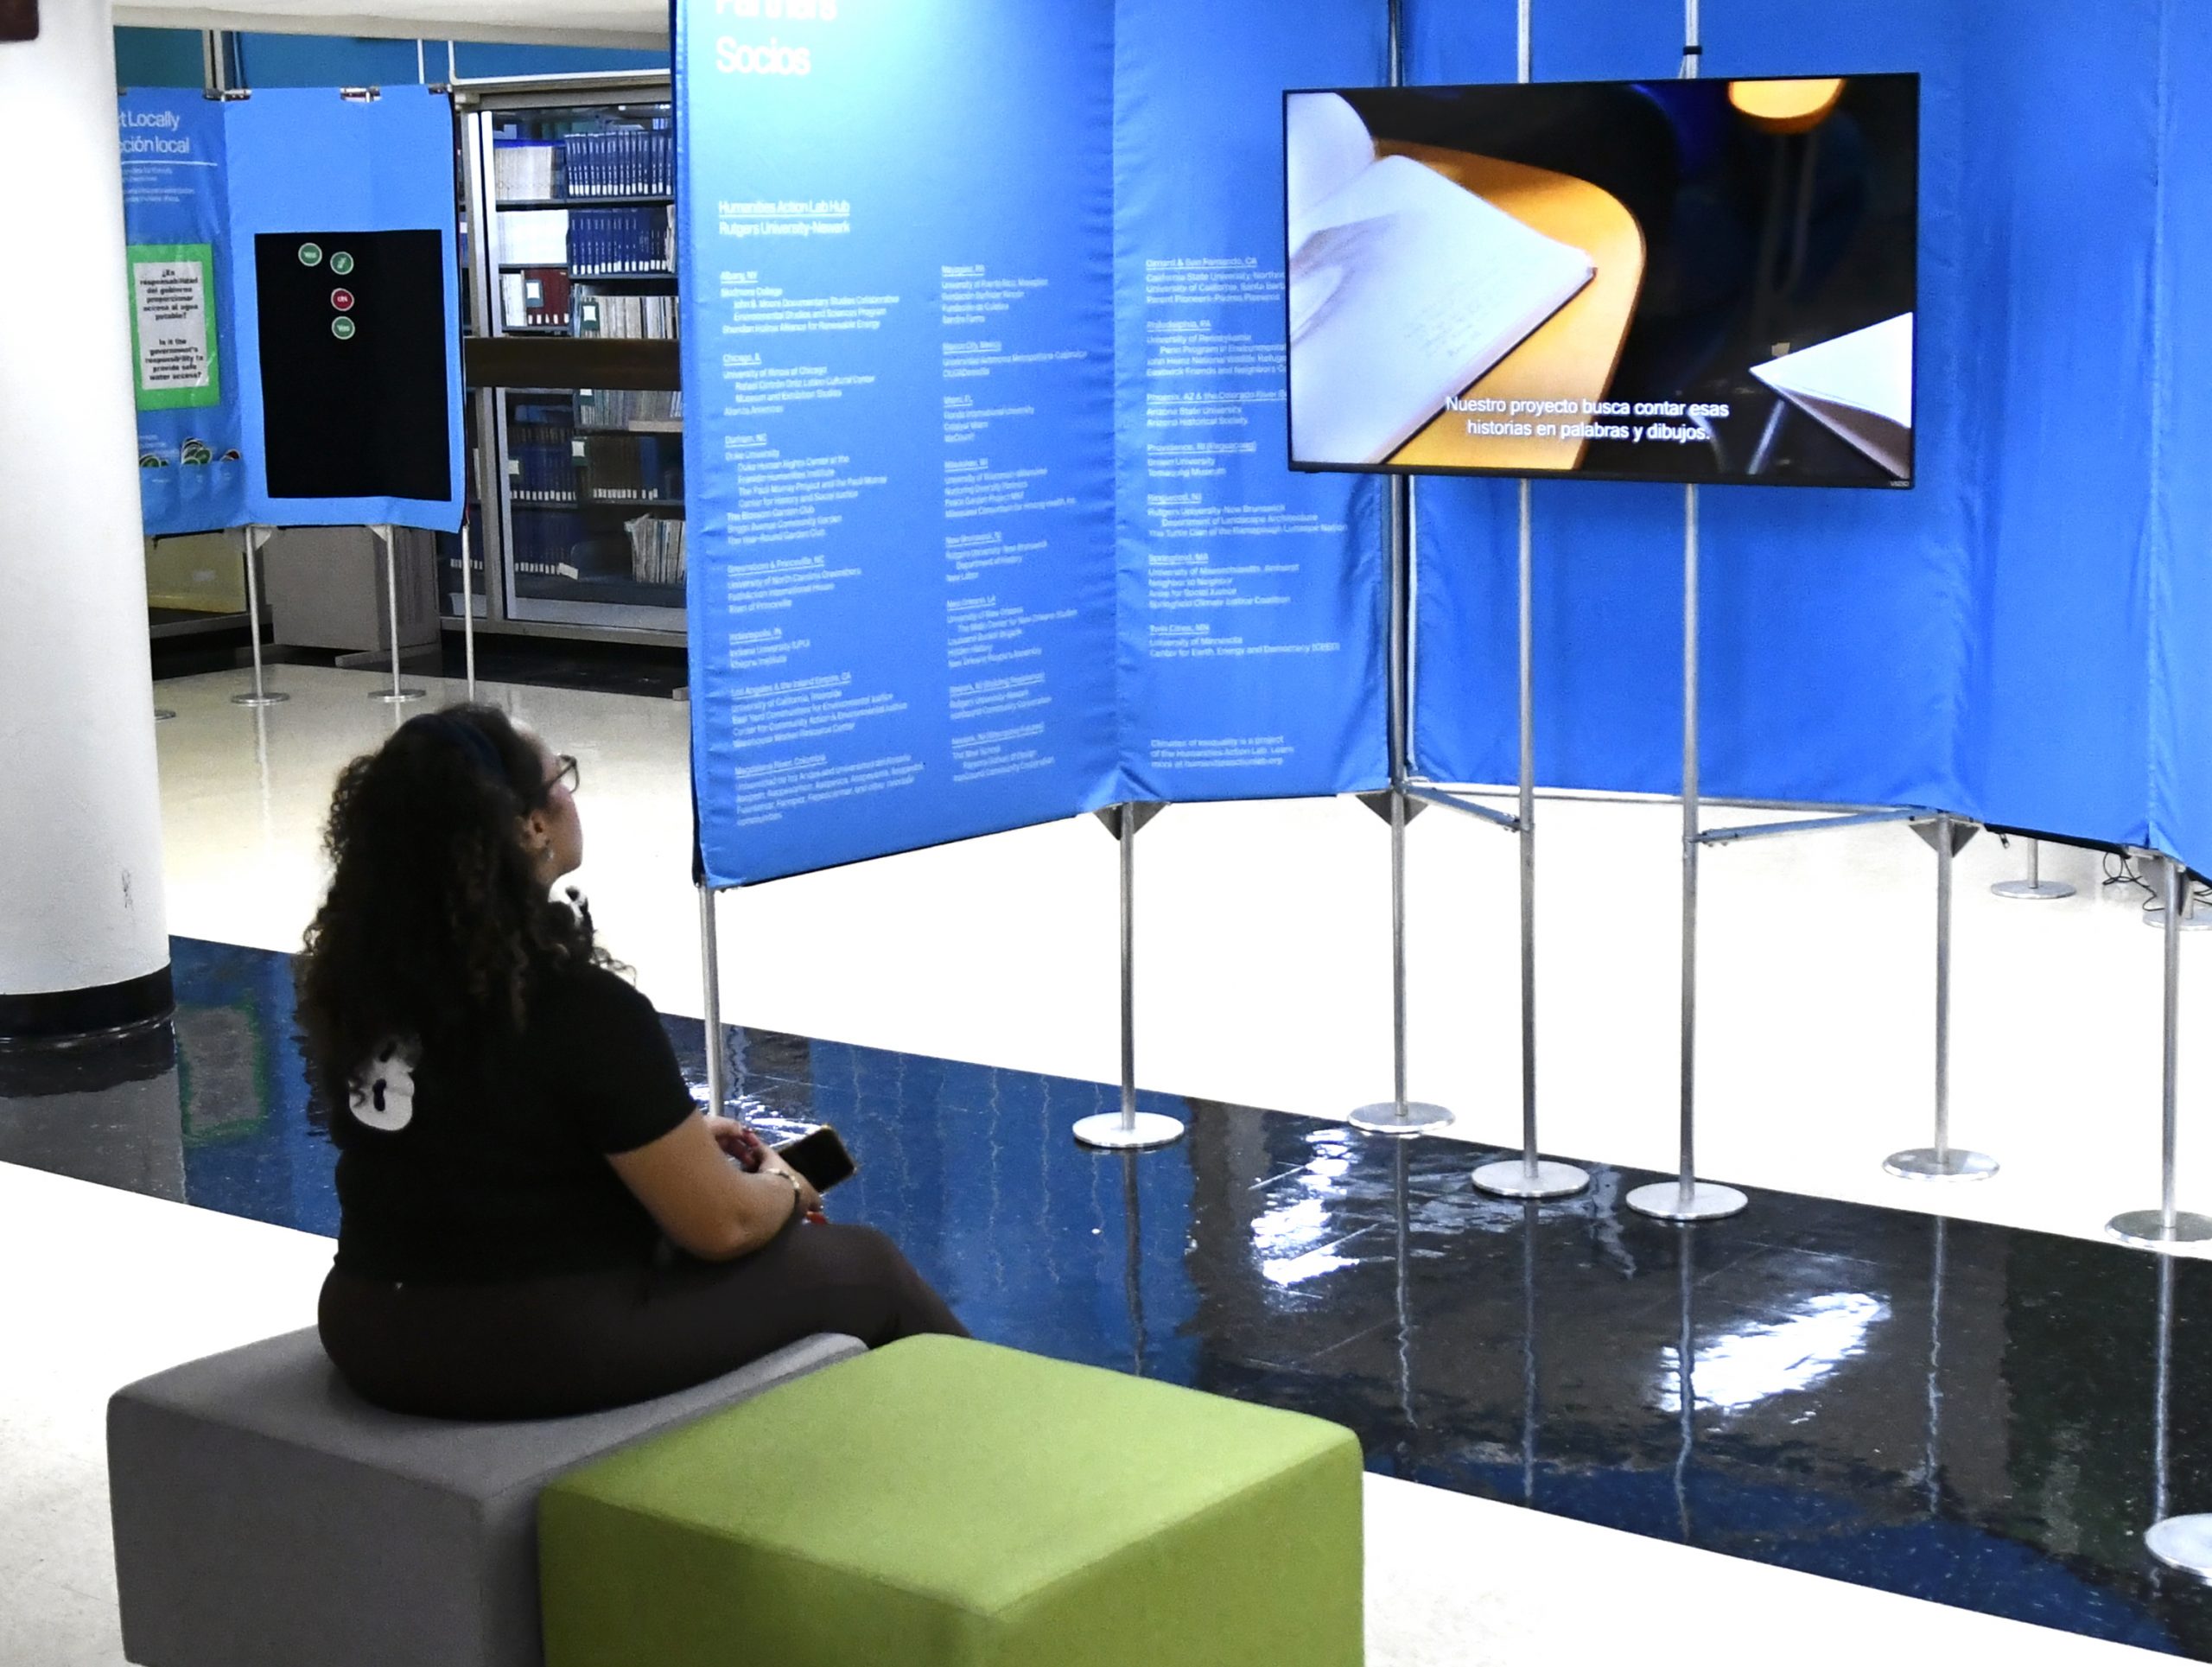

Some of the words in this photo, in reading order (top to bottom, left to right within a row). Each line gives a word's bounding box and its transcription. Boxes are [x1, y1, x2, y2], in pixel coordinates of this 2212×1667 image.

[716, 35, 811, 75] Socios
[128, 111, 180, 131] Locally
[119, 136, 154, 153] ción
[155, 136, 189, 153] local
[810, 200, 829, 213] Lab
[830, 200, 850, 213] Hub
[1446, 396, 1506, 412] Nuestro
[1510, 398, 1579, 417] proyecto
[1582, 398, 1630, 416] busca
[1634, 401, 1686, 417] contar
[1688, 404, 1730, 417] esas
[1467, 419, 1532, 436] historias
[1536, 423, 1556, 436] en
[1560, 421, 1630, 440] palabras
[1632, 427, 1643, 443] y
[1646, 423, 1712, 443] dibujos.
